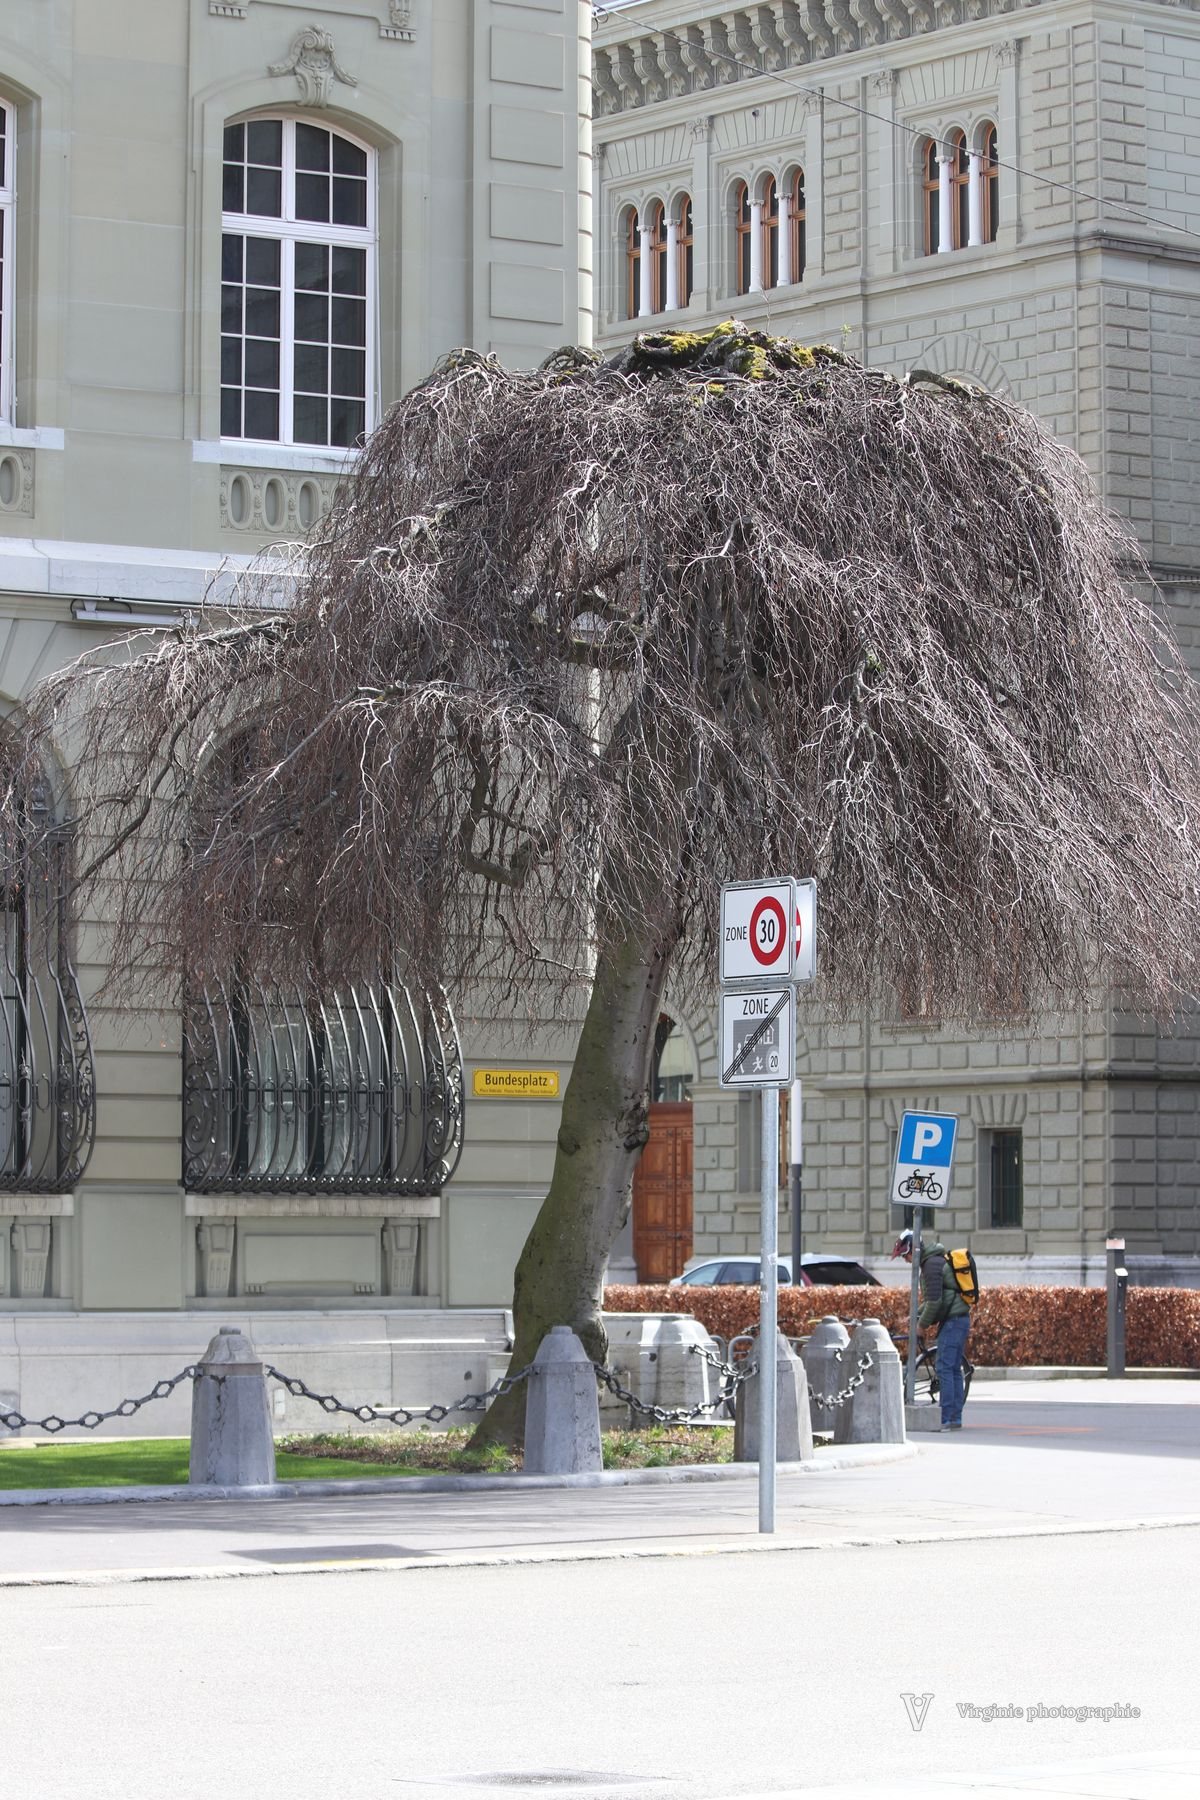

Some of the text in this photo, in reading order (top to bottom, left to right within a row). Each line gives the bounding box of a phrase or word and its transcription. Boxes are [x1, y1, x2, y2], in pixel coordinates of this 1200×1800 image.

[726, 919, 775, 943] ZONE 30
[743, 998, 769, 1015] ZONE
[770, 1055, 779, 1068] 20
[485, 1073, 548, 1088] Bundesplatz
[912, 1121, 942, 1160] P
